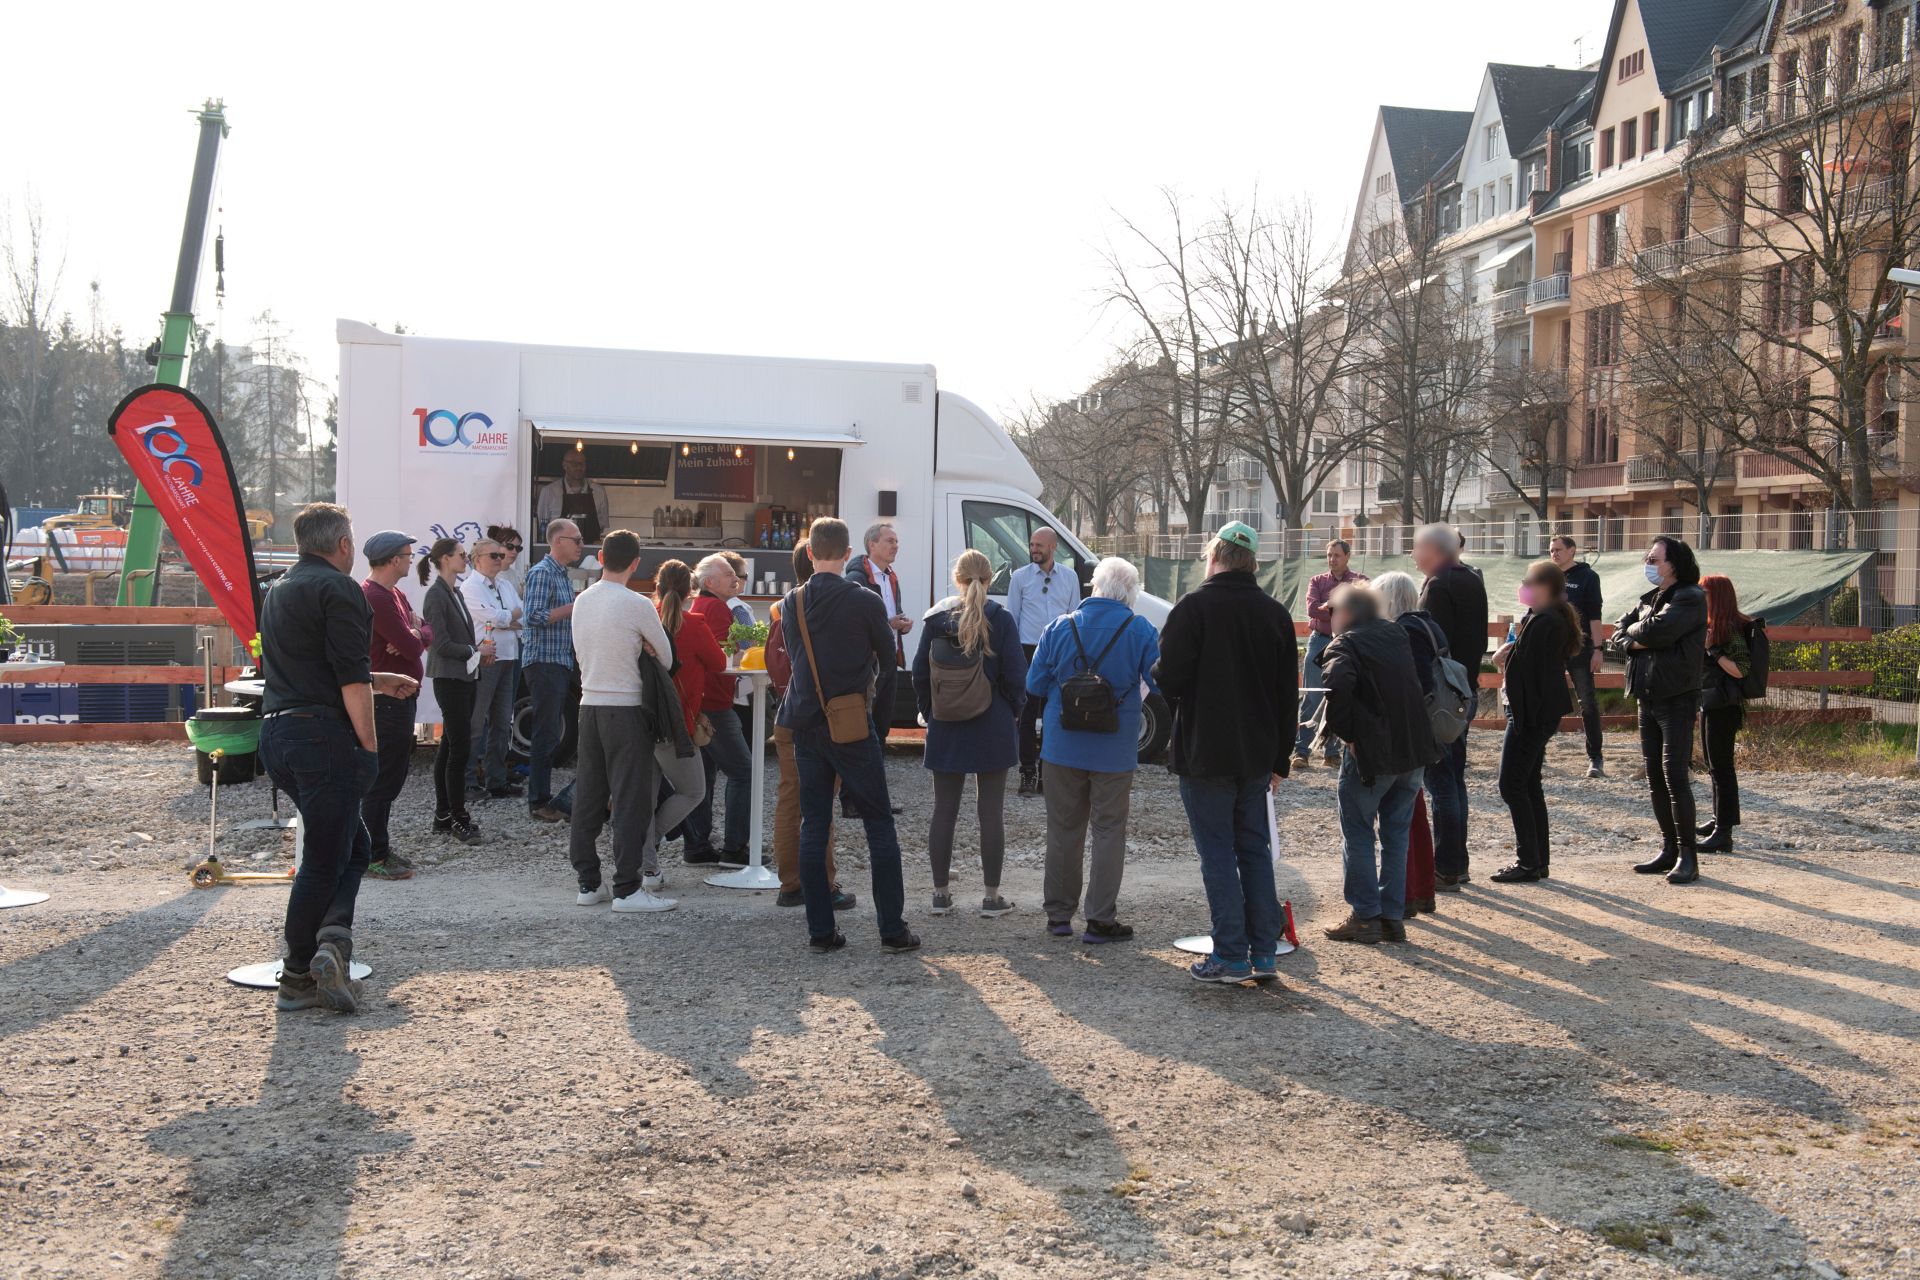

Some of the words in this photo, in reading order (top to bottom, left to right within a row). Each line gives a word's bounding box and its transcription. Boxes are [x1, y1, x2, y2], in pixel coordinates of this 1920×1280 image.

[476, 432, 508, 444] JAHRE
[678, 458, 704, 469] Mein
[706, 456, 753, 468] Zuhause.
[172, 475, 200, 507] JAHRE
